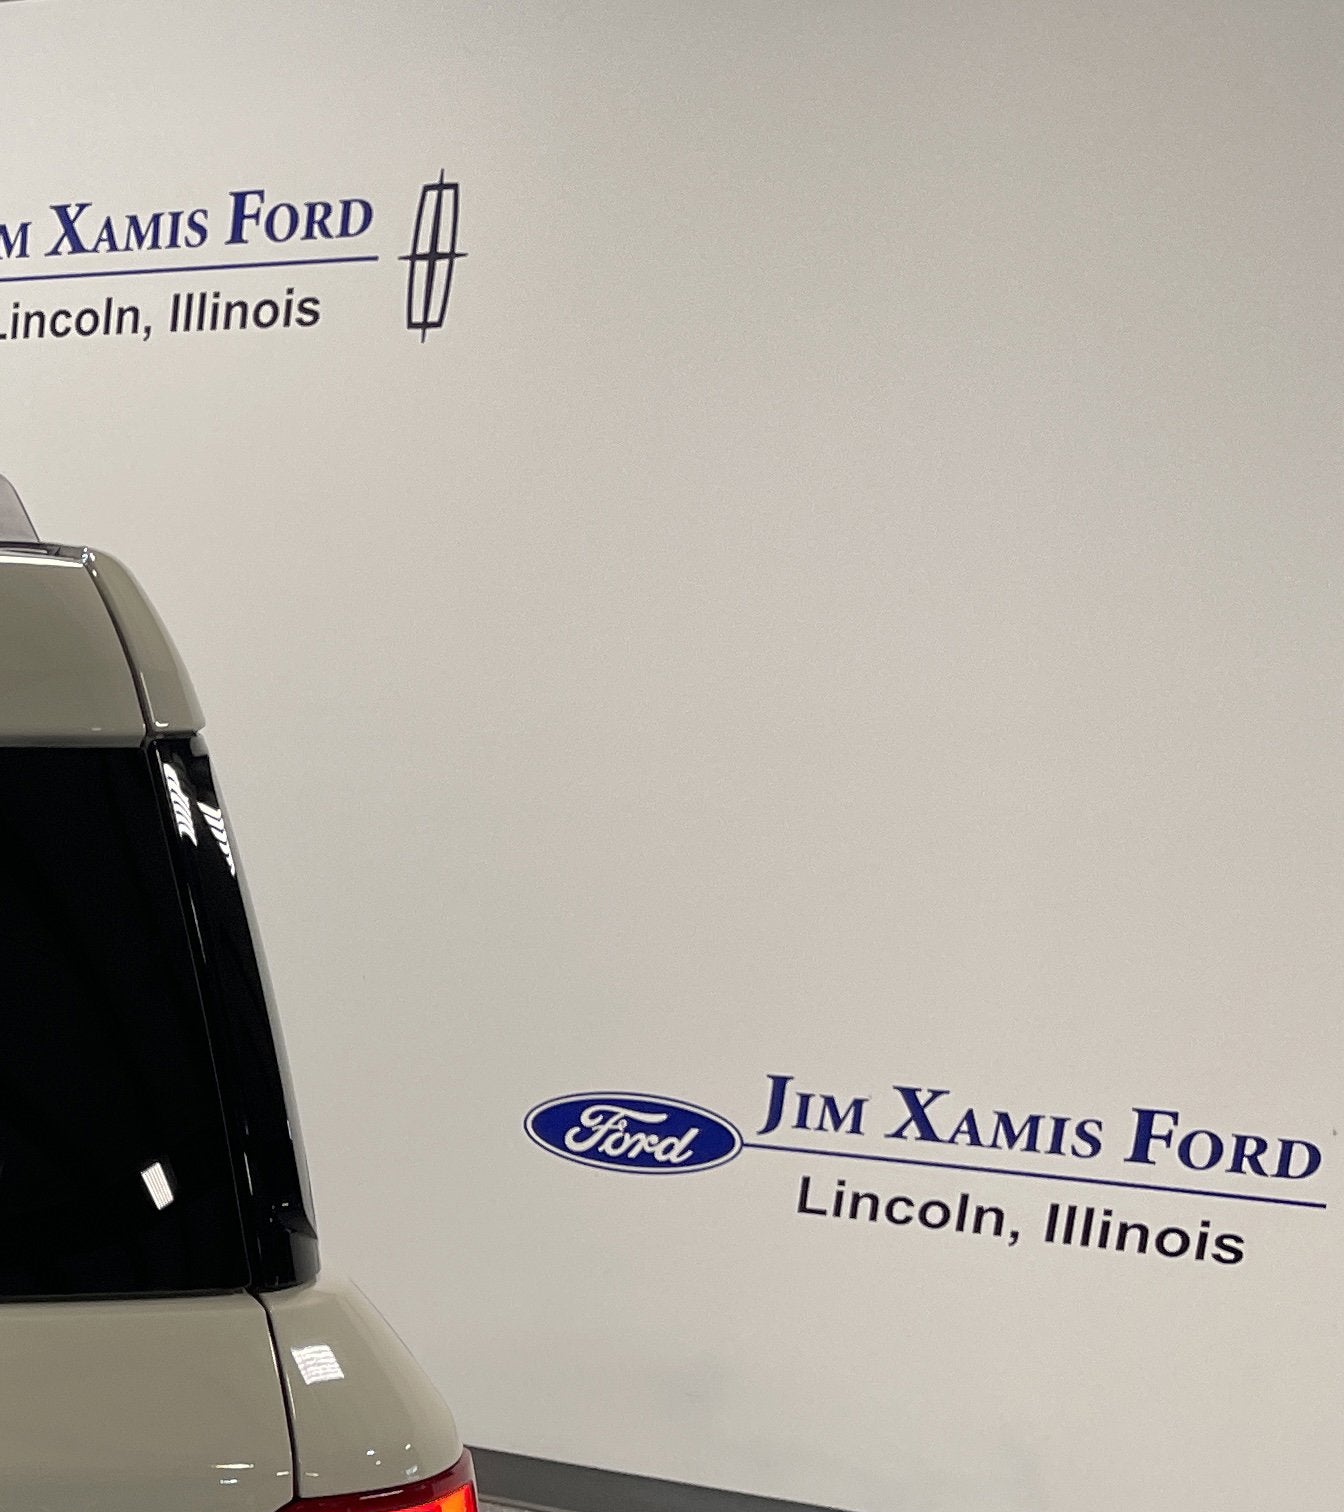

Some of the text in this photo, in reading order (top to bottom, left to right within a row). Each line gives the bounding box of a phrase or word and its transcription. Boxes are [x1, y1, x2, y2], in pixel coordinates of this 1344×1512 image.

[45, 203, 208, 255] XAMIS
[226, 189, 374, 244] FORD
[170, 288, 321, 332] Illinois
[565, 1101, 693, 1165] Ford
[758, 1074, 1322, 1181] JIM XAMIS FORD
[797, 1176, 1244, 1265] Lincoln, Illinois
